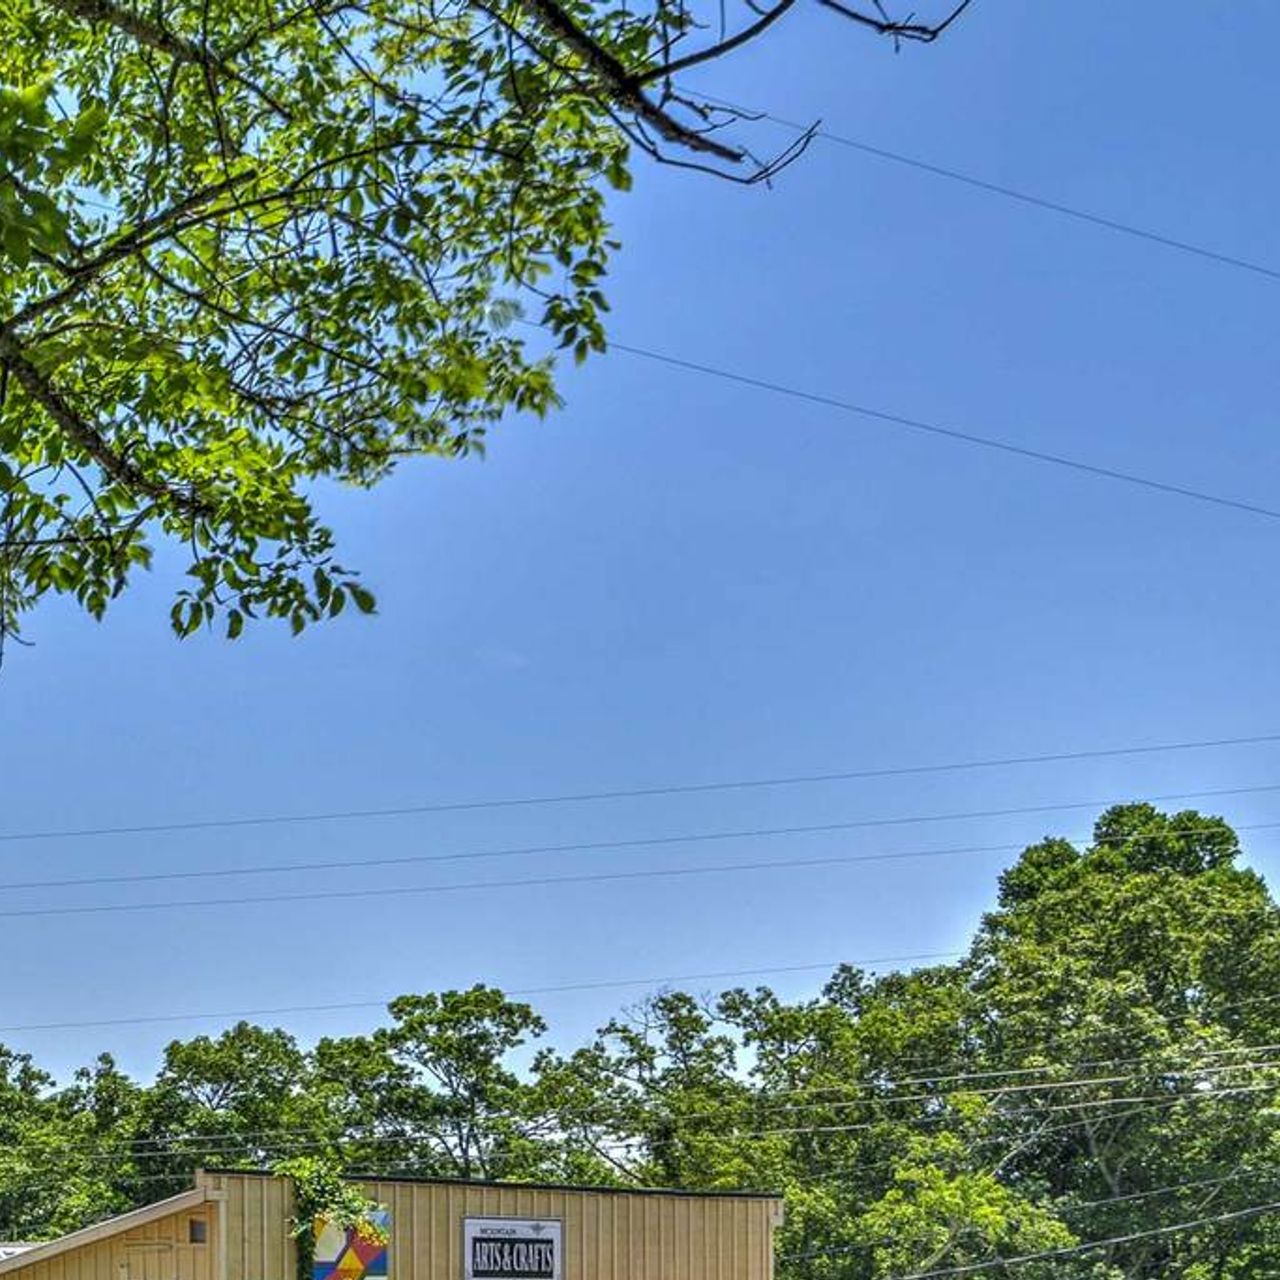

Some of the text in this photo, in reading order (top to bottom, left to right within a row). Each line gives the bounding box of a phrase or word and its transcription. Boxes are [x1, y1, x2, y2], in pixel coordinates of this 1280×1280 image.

[473, 1242, 554, 1272] ARTS & CRAFTS
